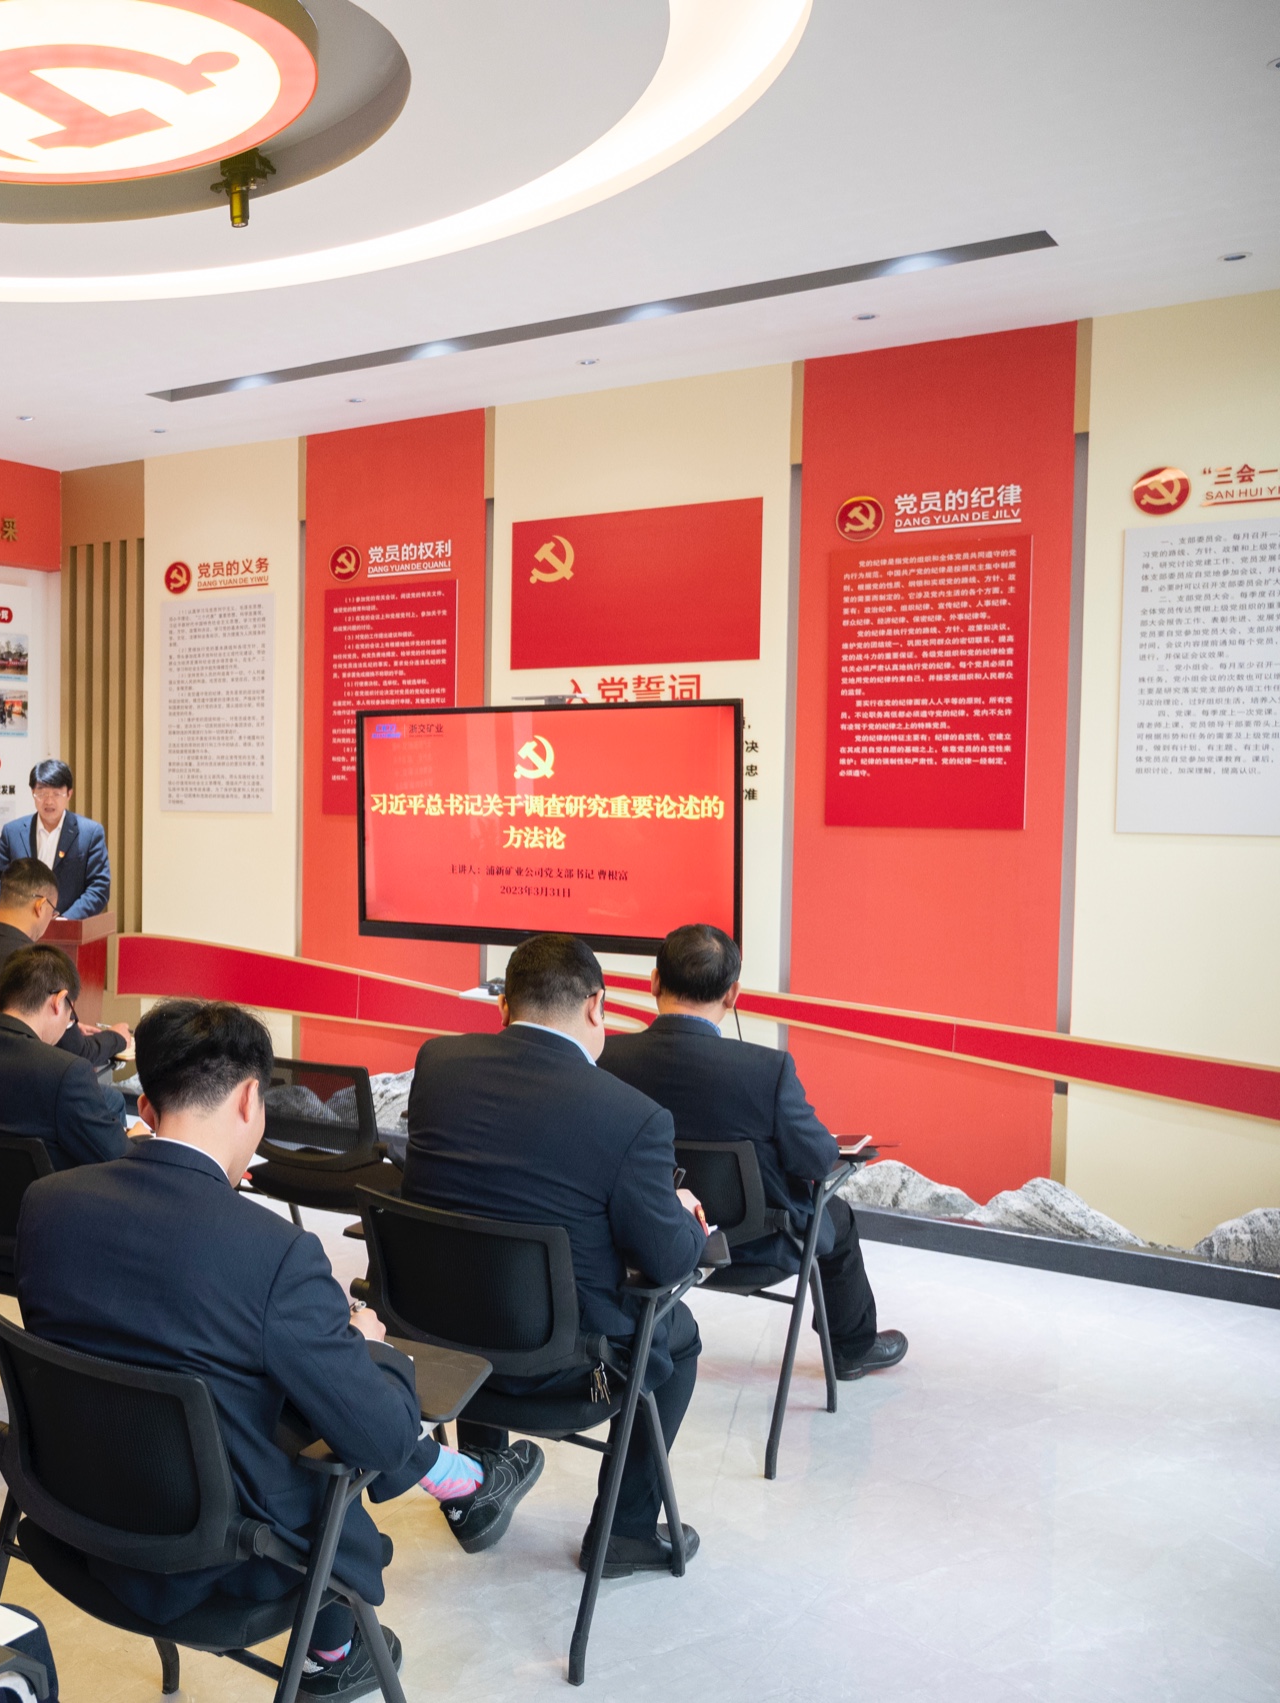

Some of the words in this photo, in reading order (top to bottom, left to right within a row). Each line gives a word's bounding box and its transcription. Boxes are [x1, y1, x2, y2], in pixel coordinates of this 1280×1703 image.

[894, 484, 1022, 516] 党员的纪律
[1206, 490, 1234, 500] SAN
[1239, 487, 1262, 498] HUI
[895, 516, 930, 528] DANG
[933, 514, 970, 524] YUAN
[972, 512, 990, 522] DE
[992, 508, 1020, 520] JILV
[368, 540, 452, 564] 党员的权利
[198, 557, 269, 579] 党员的义务
[368, 566, 389, 574] DANG
[422, 561, 451, 570] QUANLI
[219, 579, 238, 587] YUAN
[250, 576, 268, 584] YIWU
[566, 674, 701, 704] 入党誓词
[409, 724, 444, 734] 浙交矿业
[745, 740, 758, 753] 决
[746, 764, 758, 776] 忠
[371, 794, 724, 820] 习近平总书记关于调查研究重要论述的
[502, 826, 566, 850] 方法论
[598, 870, 628, 881] 曹根富
[500, 886, 571, 898] 2023年3月31日
